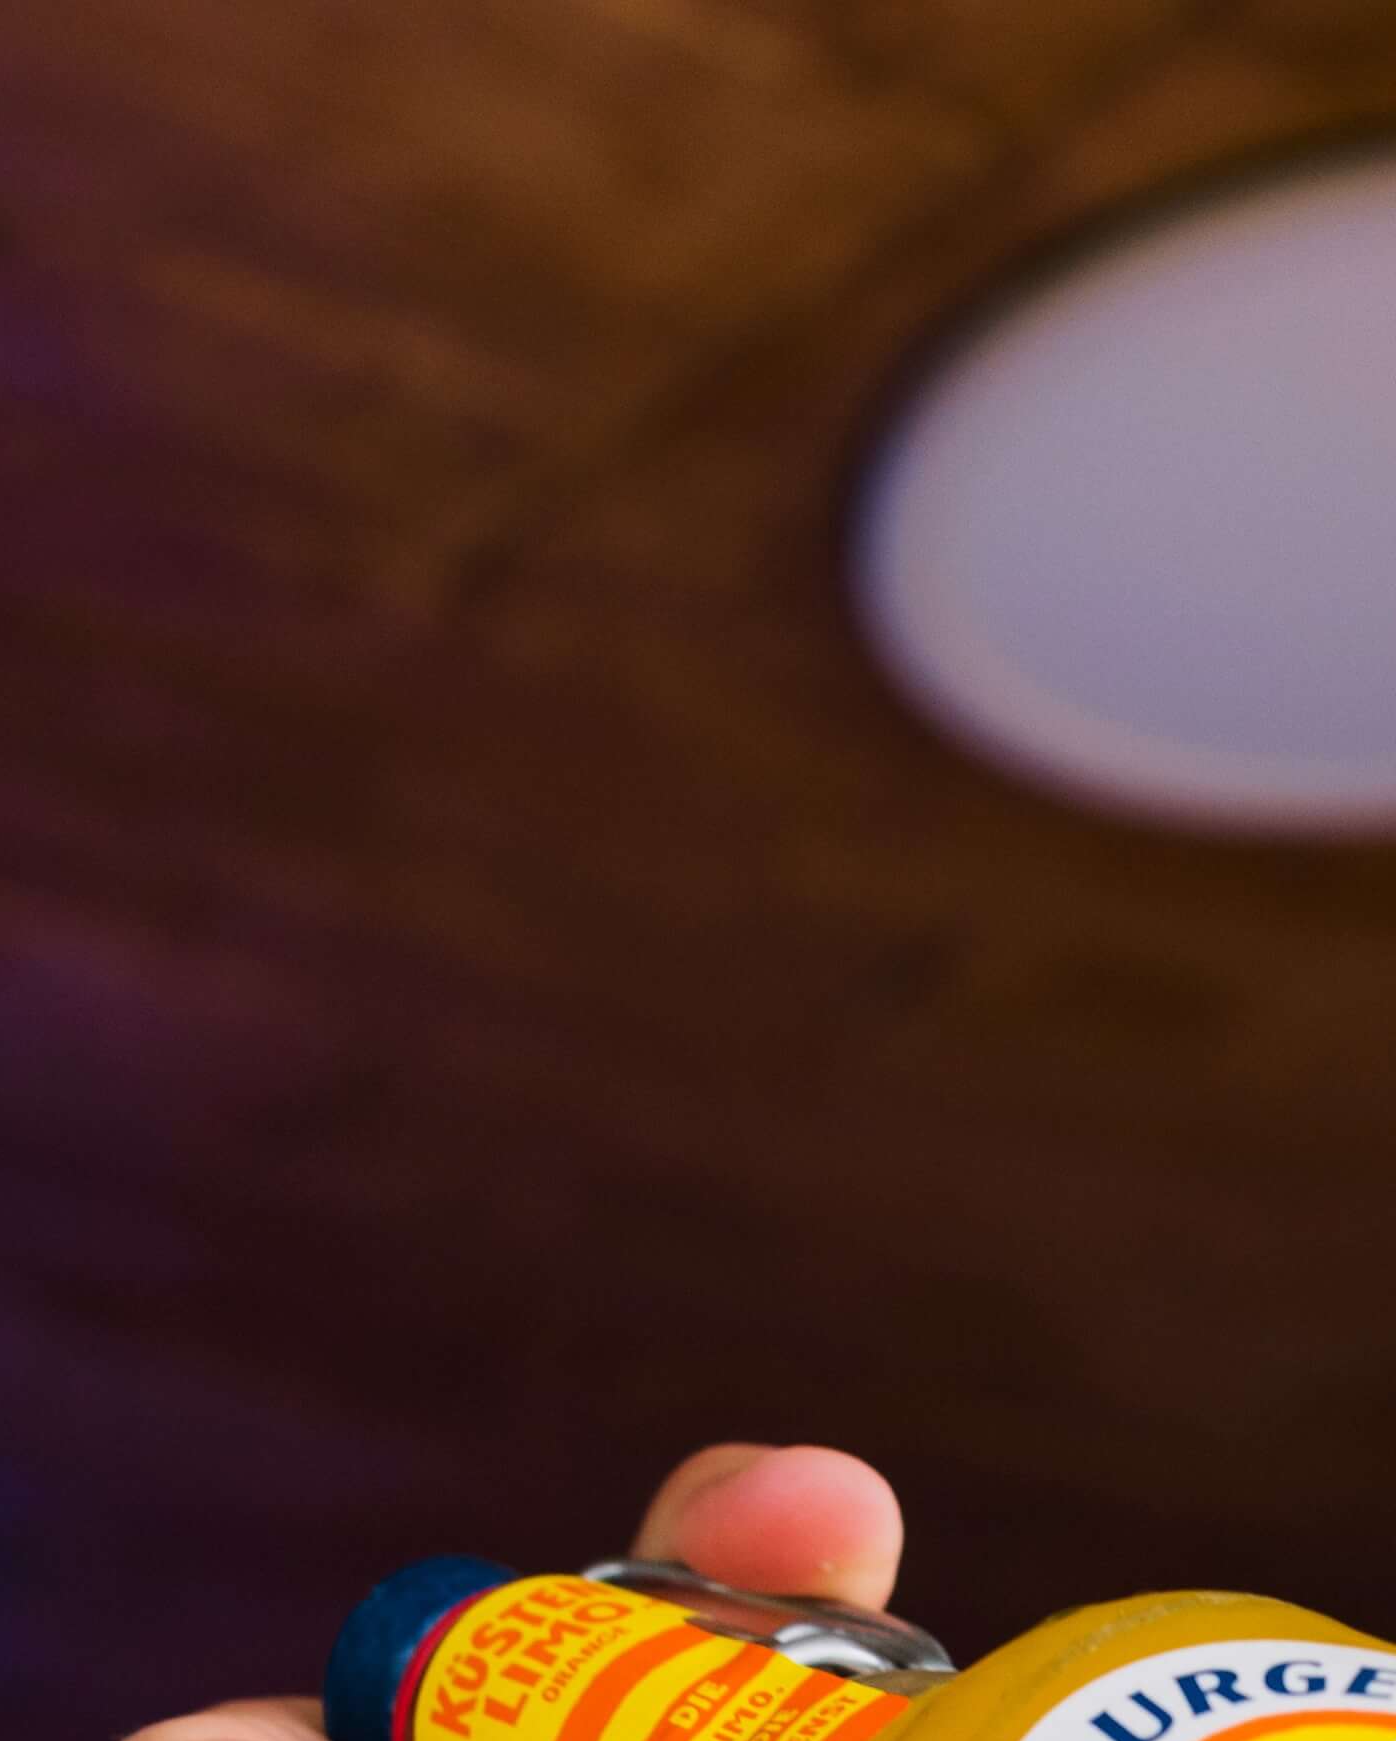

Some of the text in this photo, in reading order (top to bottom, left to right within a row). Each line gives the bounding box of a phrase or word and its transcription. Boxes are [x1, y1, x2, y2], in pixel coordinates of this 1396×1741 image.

[430, 1582, 616, 1739] KÜSTEN
[483, 1601, 633, 1727] LIMO
[540, 1624, 632, 1704] ORANGE
[668, 1679, 730, 1730] DIE
